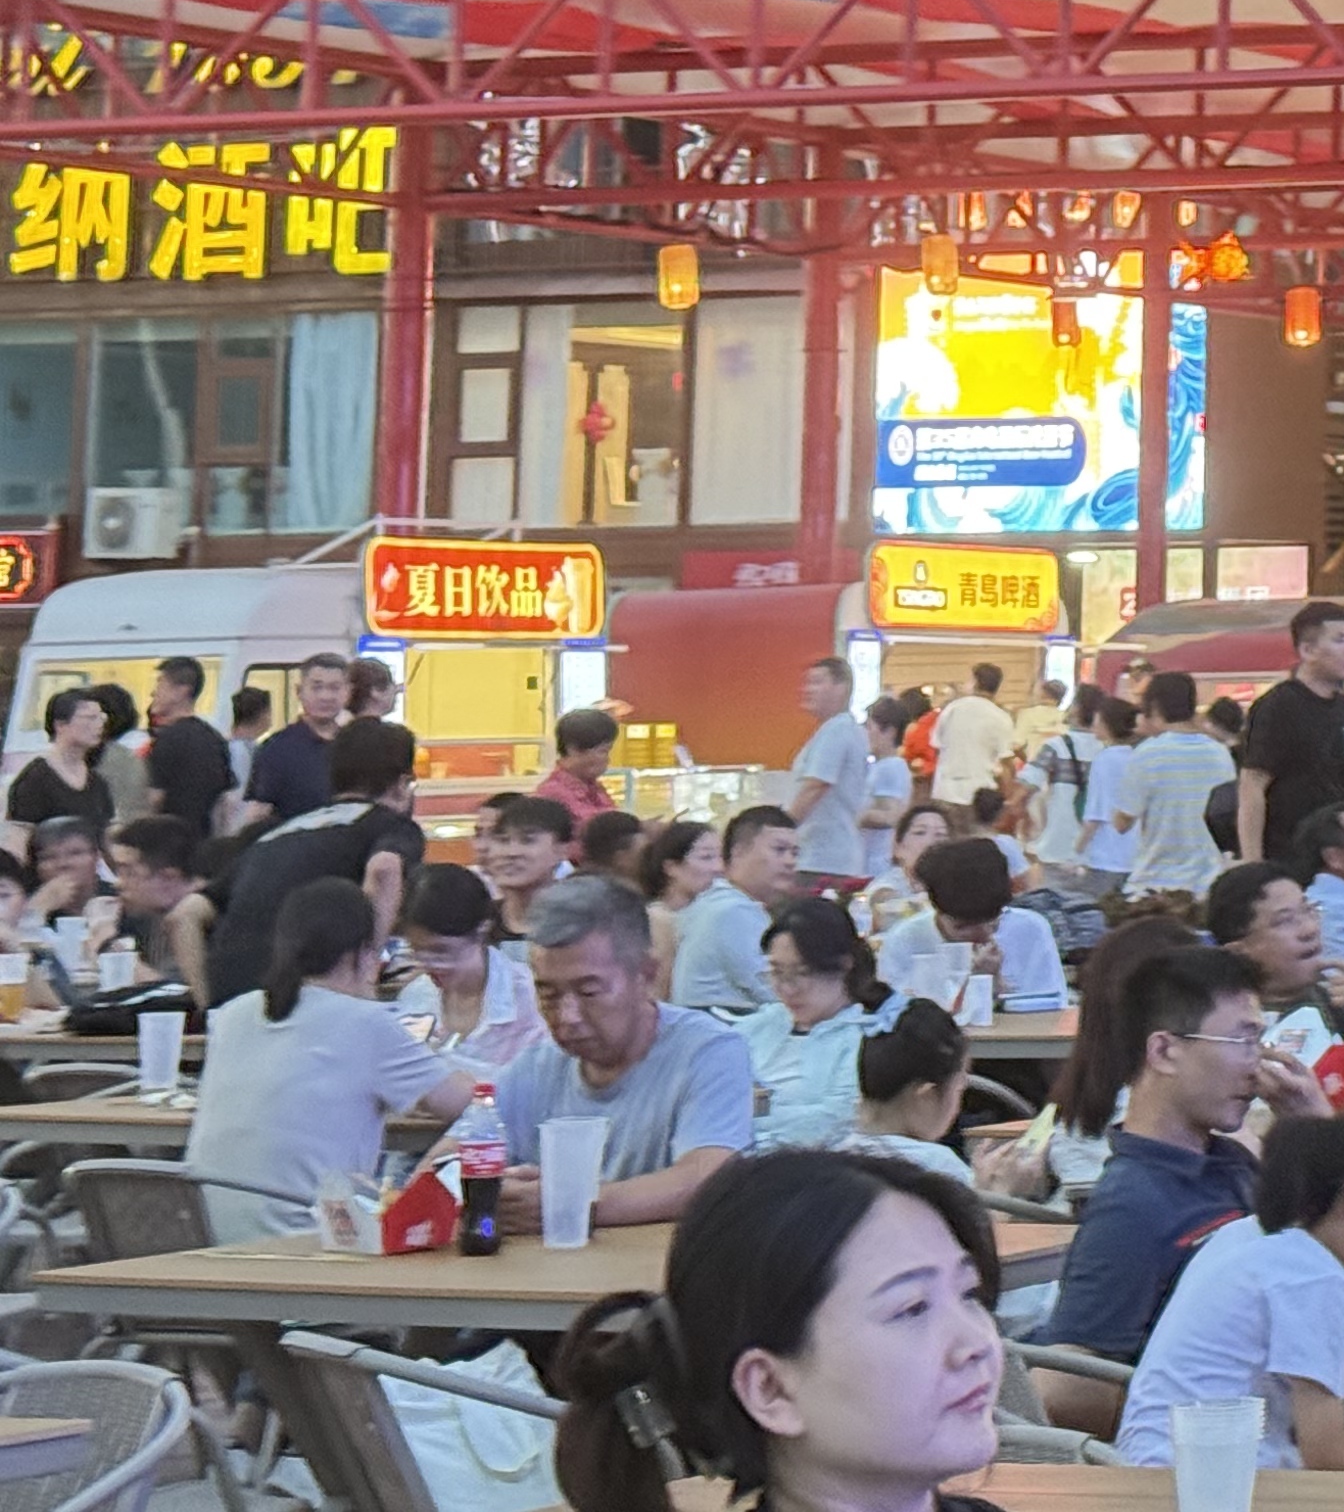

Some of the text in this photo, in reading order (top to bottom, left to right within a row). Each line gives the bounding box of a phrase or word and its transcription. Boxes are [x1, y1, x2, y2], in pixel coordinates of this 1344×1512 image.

[9, 125, 397, 282] 纳酒吧
[403, 563, 543, 618] 夏日饮品
